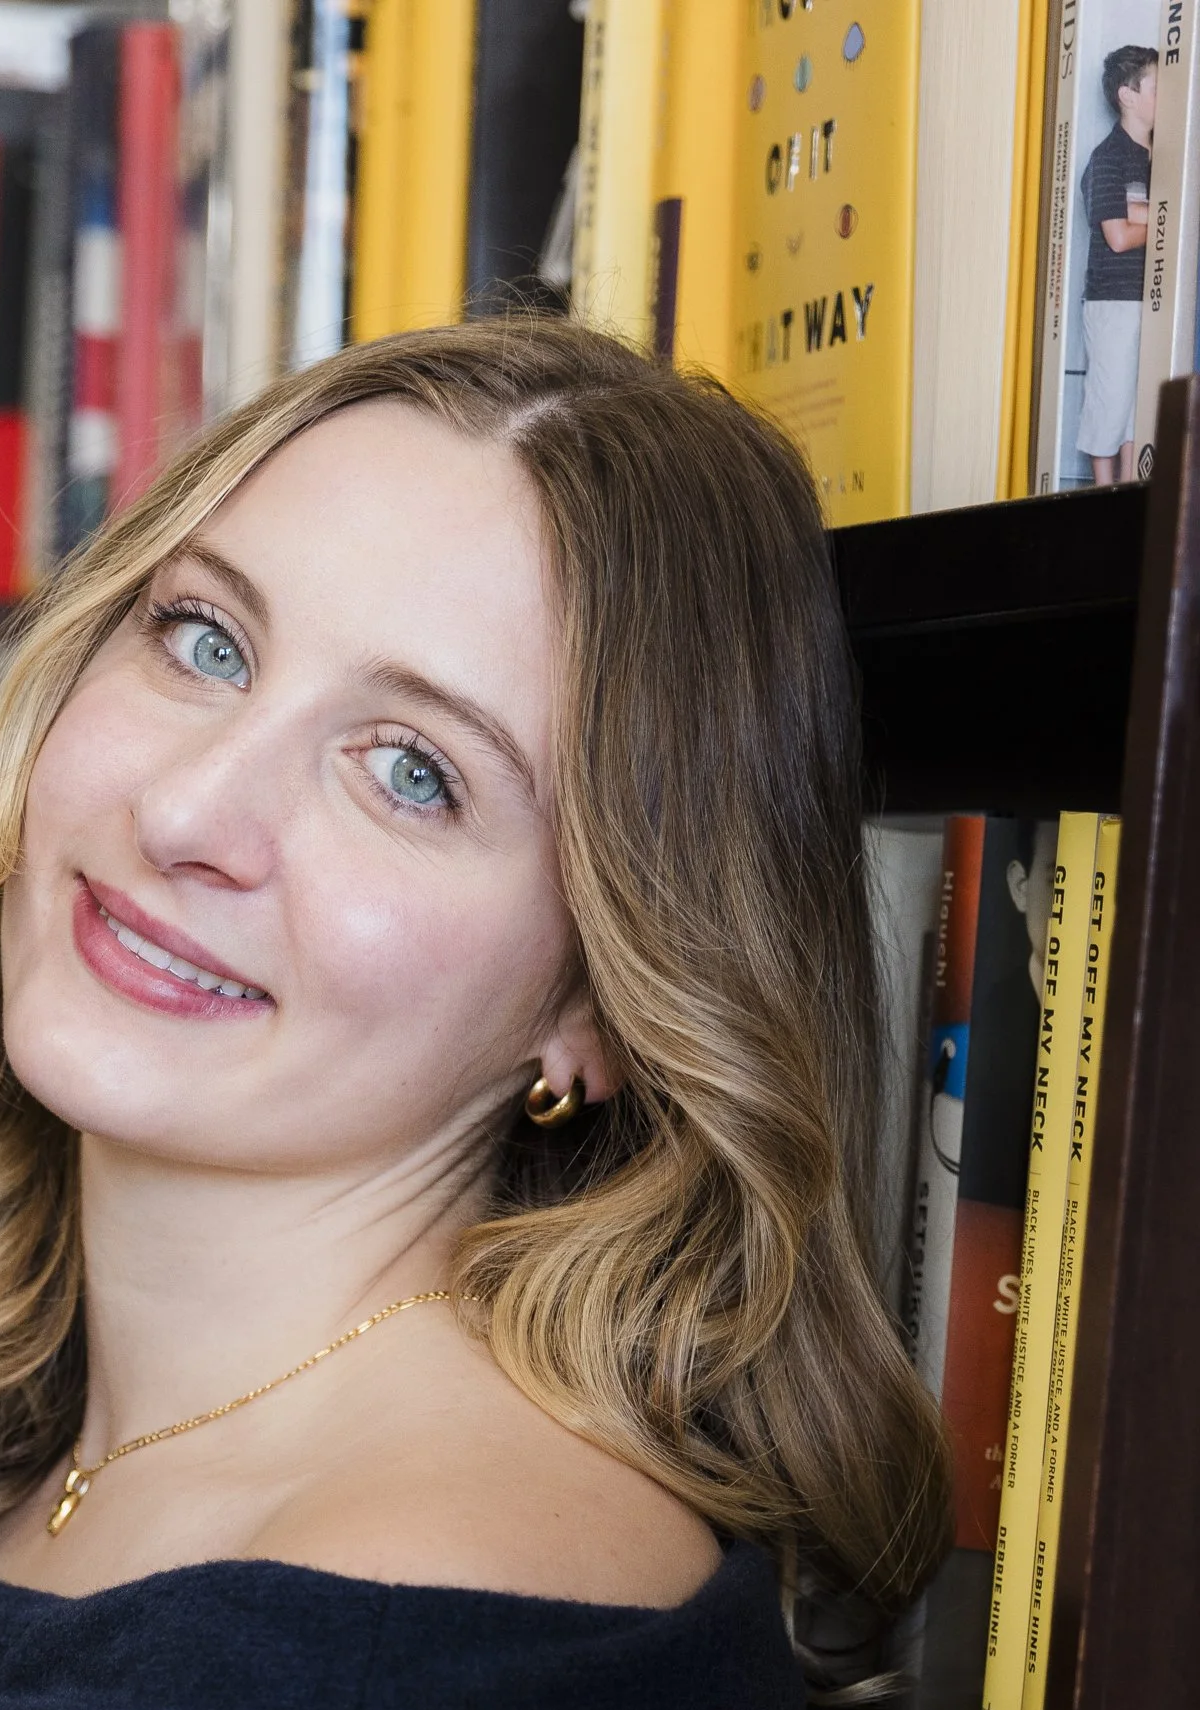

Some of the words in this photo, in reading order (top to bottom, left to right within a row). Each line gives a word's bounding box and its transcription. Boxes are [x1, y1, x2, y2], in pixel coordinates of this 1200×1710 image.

[1165, 0, 1183, 66] NCE
[765, 132, 802, 196] OF
[809, 118, 837, 181] IT
[1155, 200, 1169, 251] Kazu
[1150, 258, 1165, 312] Haga
[804, 282, 875, 354] WAY
[1052, 866, 1067, 925] GET
[1091, 871, 1106, 932] GET
[1046, 937, 1060, 996] OFF
[1085, 943, 1099, 1004] OFF
[1040, 1008, 1054, 1056] MY
[1080, 1016, 1094, 1064] MY
[1032, 1066, 1049, 1153] NECK
[1071, 1075, 1088, 1163] NECK
[1029, 1189, 1040, 1233] BLACK
[1068, 1200, 1079, 1245] BLACK
[1021, 1283, 1032, 1325] WHITE
[1060, 1295, 1071, 1337] WHITE
[1012, 1422, 1020, 1431] A
[1013, 1390, 1022, 1418] AND
[1052, 1402, 1061, 1431] AND
[1007, 1435, 1019, 1489] FORMER
[1051, 1435, 1058, 1444] A
[1046, 1448, 1057, 1503] FORMER
[994, 1526, 1007, 1594] DEBBIE
[1033, 1541, 1046, 1610] DEBBIE
[989, 1600, 1000, 1657] HINES
[1028, 1616, 1040, 1673] HINES
